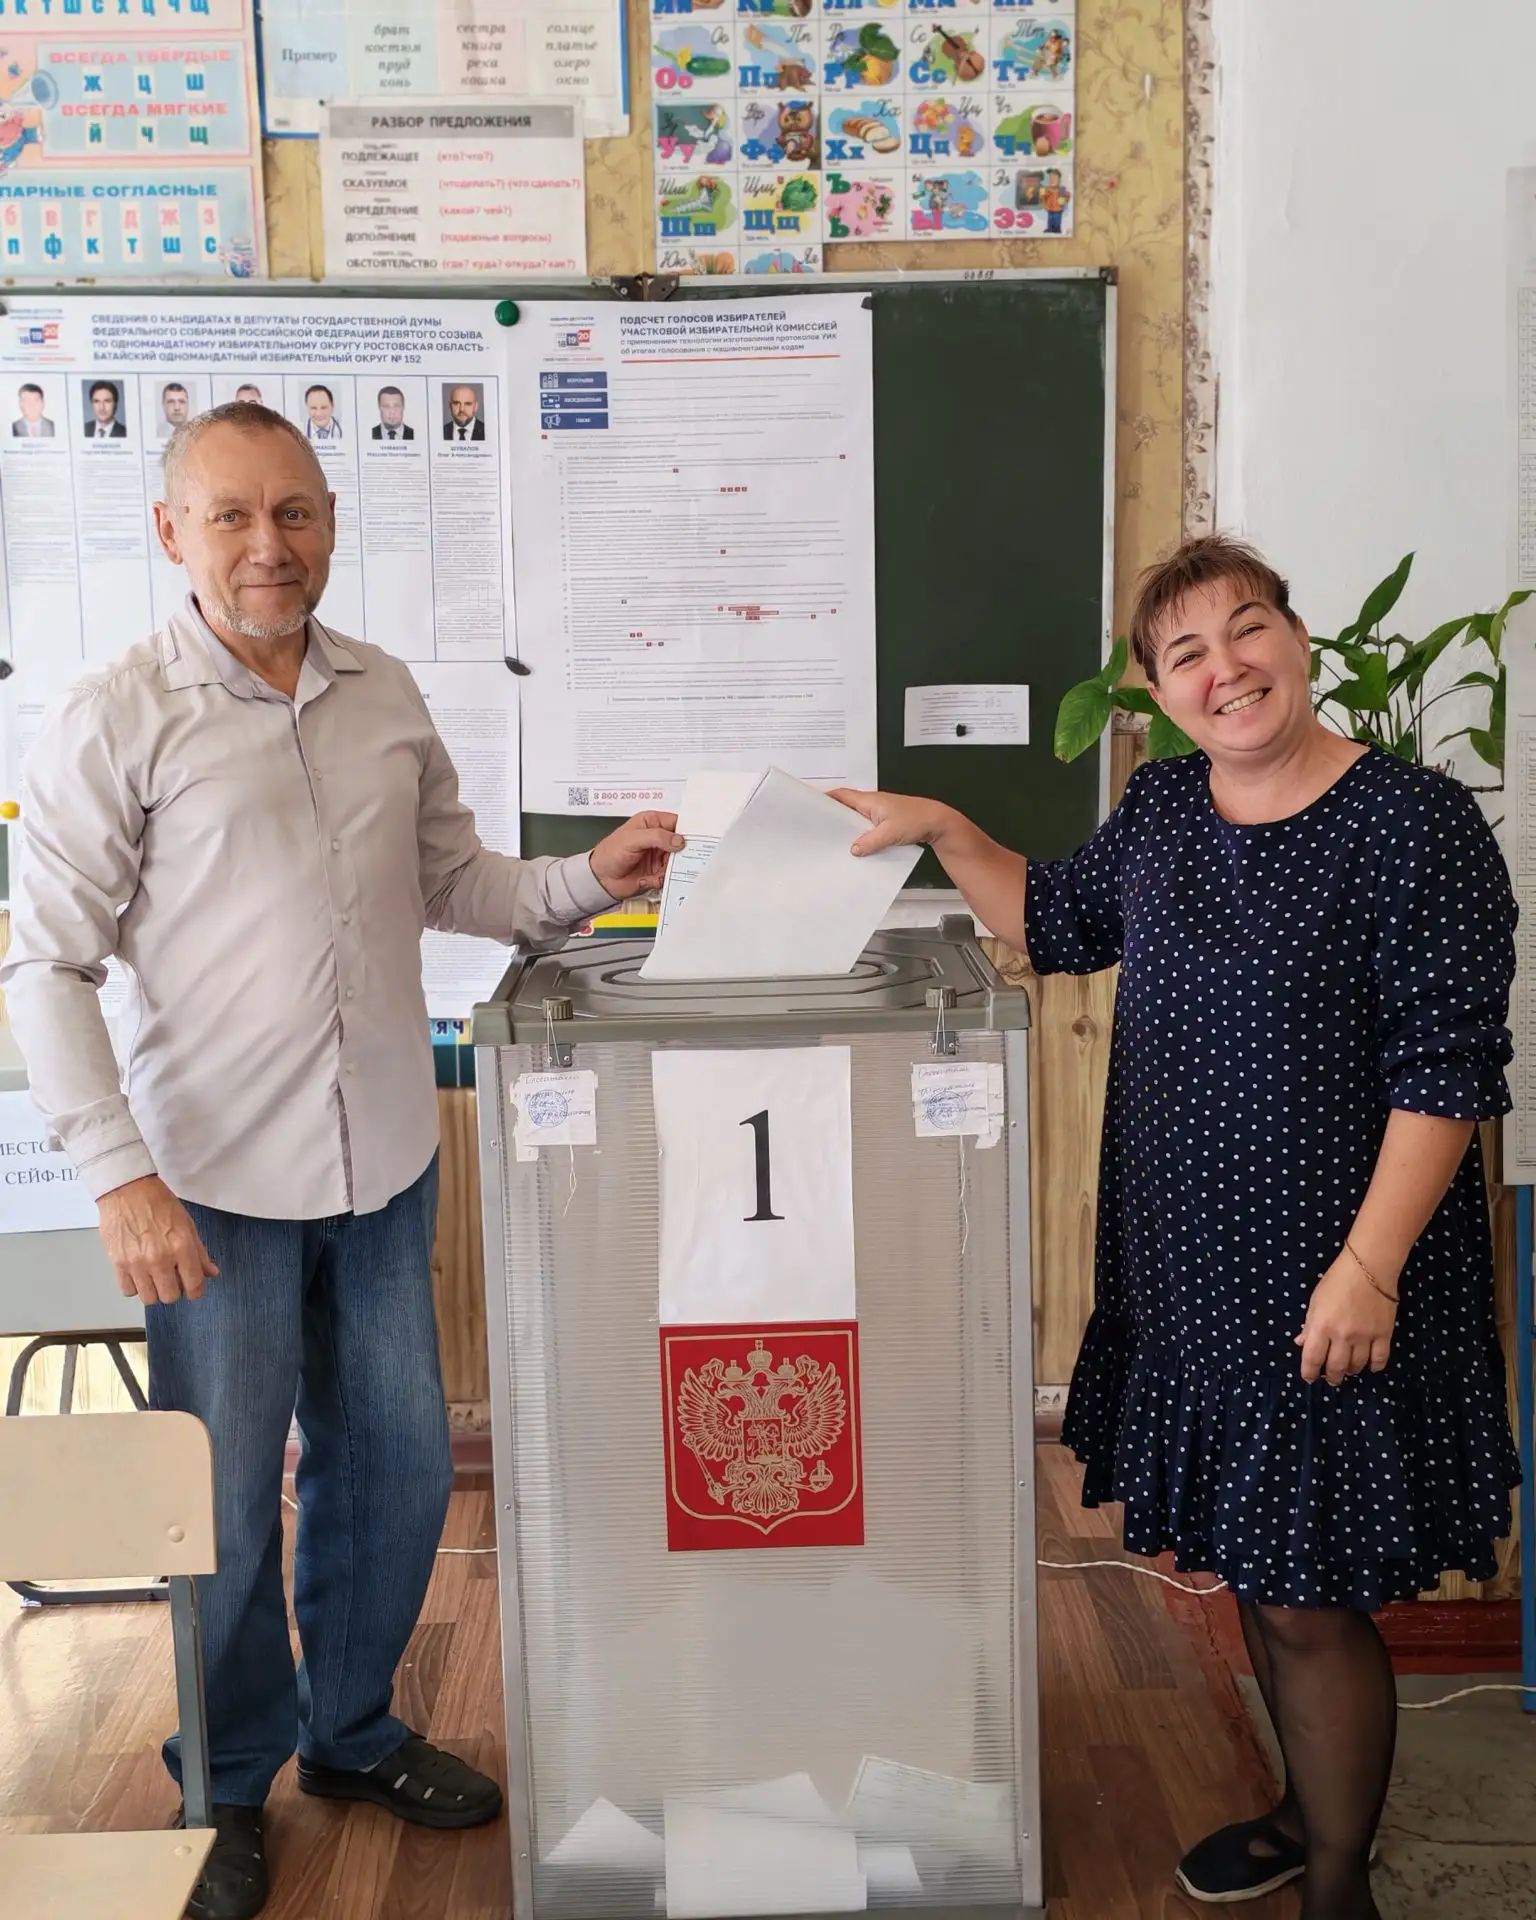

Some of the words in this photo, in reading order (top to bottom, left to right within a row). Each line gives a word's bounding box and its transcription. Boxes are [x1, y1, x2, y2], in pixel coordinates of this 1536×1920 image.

[374, 24, 410, 37] брат
[456, 23, 506, 34] сестра
[547, 24, 596, 35] солнце
[365, 43, 422, 53] костюм
[461, 41, 503, 51] книга
[545, 41, 597, 51] платье
[50, 52, 129, 65] ВСЕГДА
[136, 50, 232, 64] ТВЕРДЫЕ
[282, 48, 337, 63] Пример
[378, 59, 411, 73] пруд
[466, 57, 499, 70] река
[554, 58, 590, 70] озеро
[909, 60, 947, 84] Сс
[992, 60, 1030, 81] Тт
[379, 77, 412, 88] конь
[461, 76, 506, 87] кошка
[556, 76, 590, 86] окно
[61, 103, 140, 117] ВСЕГДА
[147, 102, 228, 116] МЯГКИЕ
[371, 117, 424, 128] РАЗБОР
[430, 115, 531, 129] ПРЕДЛОЖЕНИЯ
[825, 139, 865, 160] Хх
[994, 134, 1032, 156] Чч
[341, 151, 420, 162] ПОДЛЕЖАЩЕЕ
[342, 179, 408, 188] СКАЗУЕМОЕ
[0, 185, 86, 198] ПАРНЫЕ
[92, 184, 218, 198] СОГЛАСНЫЕ
[344, 205, 419, 216] ОПРЕДЕЛЕНИЕ
[743, 209, 800, 234] Щщ
[993, 207, 1034, 229] Ээ
[660, 216, 716, 236] Шш
[345, 232, 416, 243] ДОПОЛНЕНИЕ
[346, 259, 438, 269] ОБСТОЯТЕЛЬСТВО
[91, 314, 148, 324] СВЕДЕНИЯ
[151, 315, 158, 324] О
[161, 315, 231, 325] КАНДИДАТАХ
[234, 315, 241, 324] В
[244, 316, 299, 326] ДЕПУТАТЫ
[302, 315, 407, 326] ГОСУДАРСТВЕННОЙ
[410, 317, 442, 327] ДУМЫ
[620, 316, 665, 326] ПОДСЧЕТ
[667, 314, 714, 324] ГОЛОСОВ
[716, 310, 787, 322] ИЗБИРАТЕЛЕЙ
[92, 327, 177, 337] ФЕДЕРАЛЬНОГО
[180, 327, 236, 337] СОБРАНИЯ
[239, 327, 312, 338] РОССИЙСКОЙ
[314, 329, 380, 339] ФЕДЕРАЦИИ
[382, 329, 436, 340] ДЕВЯТОГО
[439, 330, 483, 340] СОЗЫВА
[621, 325, 687, 336] УЧАСТКОВОЙ
[689, 323, 773, 335] ИЗБИРАТЕЛЬНОЙ
[776, 321, 838, 332] КОМИССИЕЙ
[92, 340, 108, 349] ПО
[111, 339, 216, 350] ОДНОМАНДАТНОМУ
[218, 340, 317, 350] ИЗБИРАТЕЛЬНОМУ
[320, 341, 361, 351] ОКРУГУ
[363, 342, 434, 351] РОСТОВСКАЯ
[436, 343, 484, 352] ОБЛАСТЬ
[94, 350, 157, 361] БАТАЙСКИЙ
[159, 351, 258, 362] ОДНОМАНДАТНЫЙ
[260, 352, 353, 364] ИЗБИРАТЕЛЬНЫЙ
[355, 354, 388, 363] ОКРУГ
[391, 354, 403, 363] №
[404, 354, 422, 364] 152
[601, 792, 619, 800] 800
[620, 792, 637, 800] 200
[639, 792, 650, 800] 00
[652, 792, 663, 800] 20
[739, 1109, 785, 1222] 1
